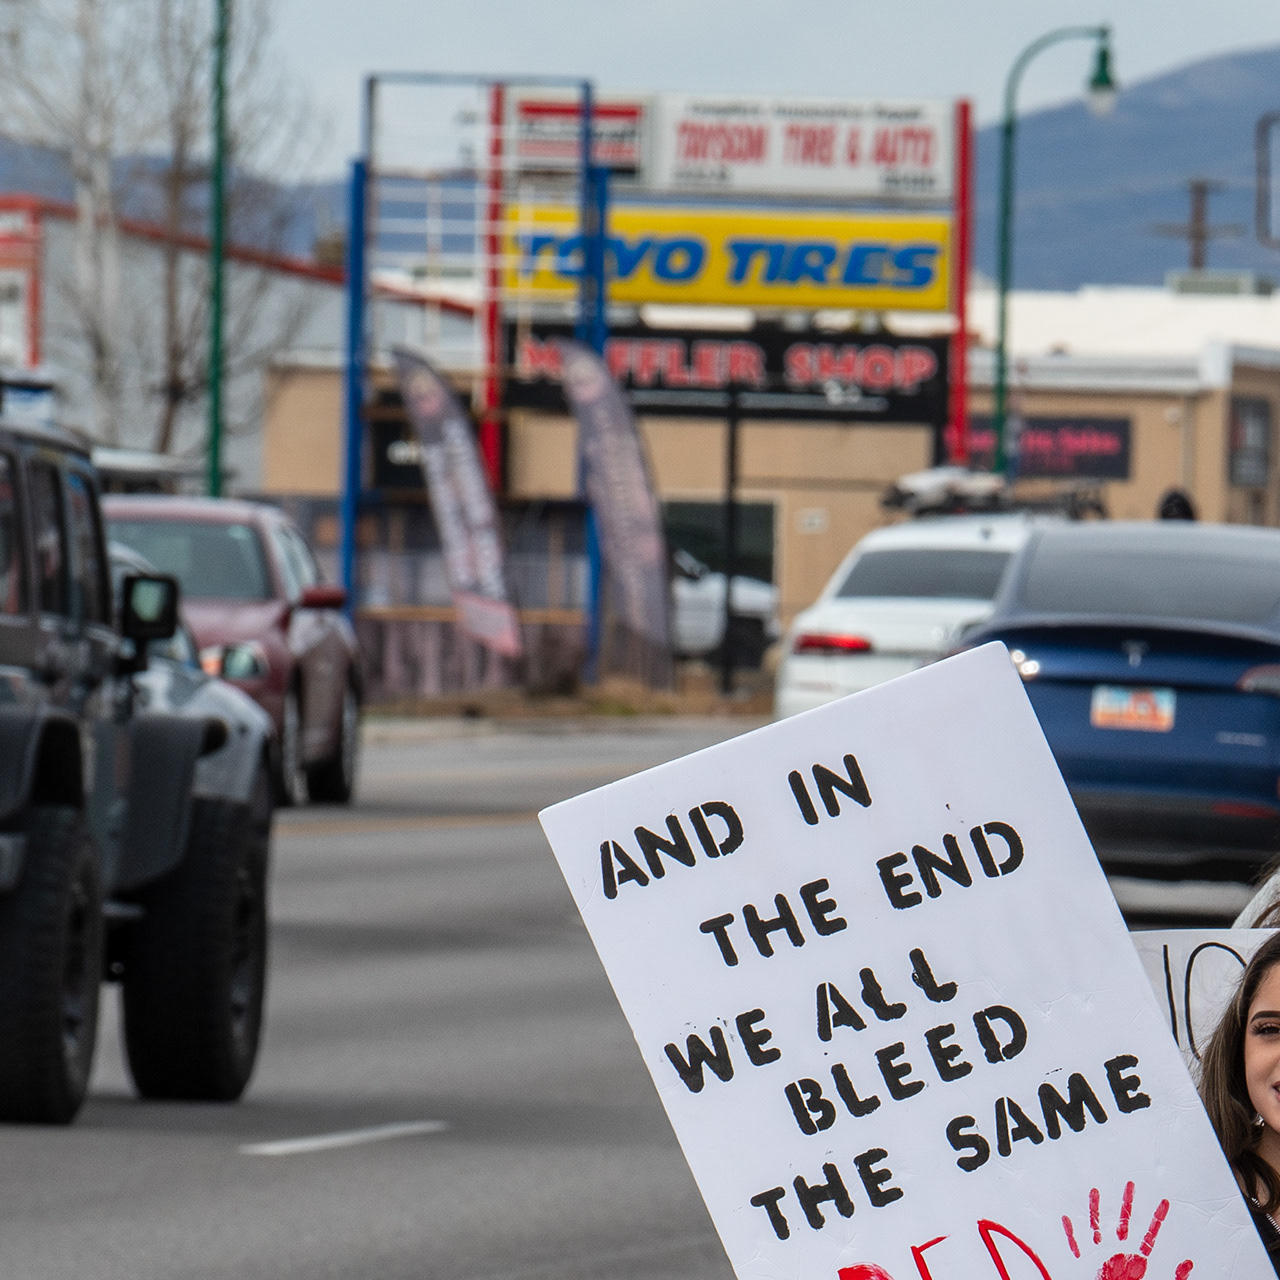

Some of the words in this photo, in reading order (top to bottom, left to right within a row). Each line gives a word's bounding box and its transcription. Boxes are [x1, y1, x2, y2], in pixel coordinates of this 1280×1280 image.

[726, 238, 943, 291] TIRES
[522, 337, 766, 388] MFFLER
[783, 343, 938, 393] SHOP
[599, 801, 745, 899] AND
[787, 753, 873, 826] IN
[700, 878, 848, 967] THE
[876, 821, 1025, 910] END
[664, 1008, 781, 1093] WE
[816, 948, 958, 1042] ALL
[784, 1005, 1028, 1135] BLEED
[750, 1147, 904, 1240] THE
[945, 1054, 1152, 1172] SAME
